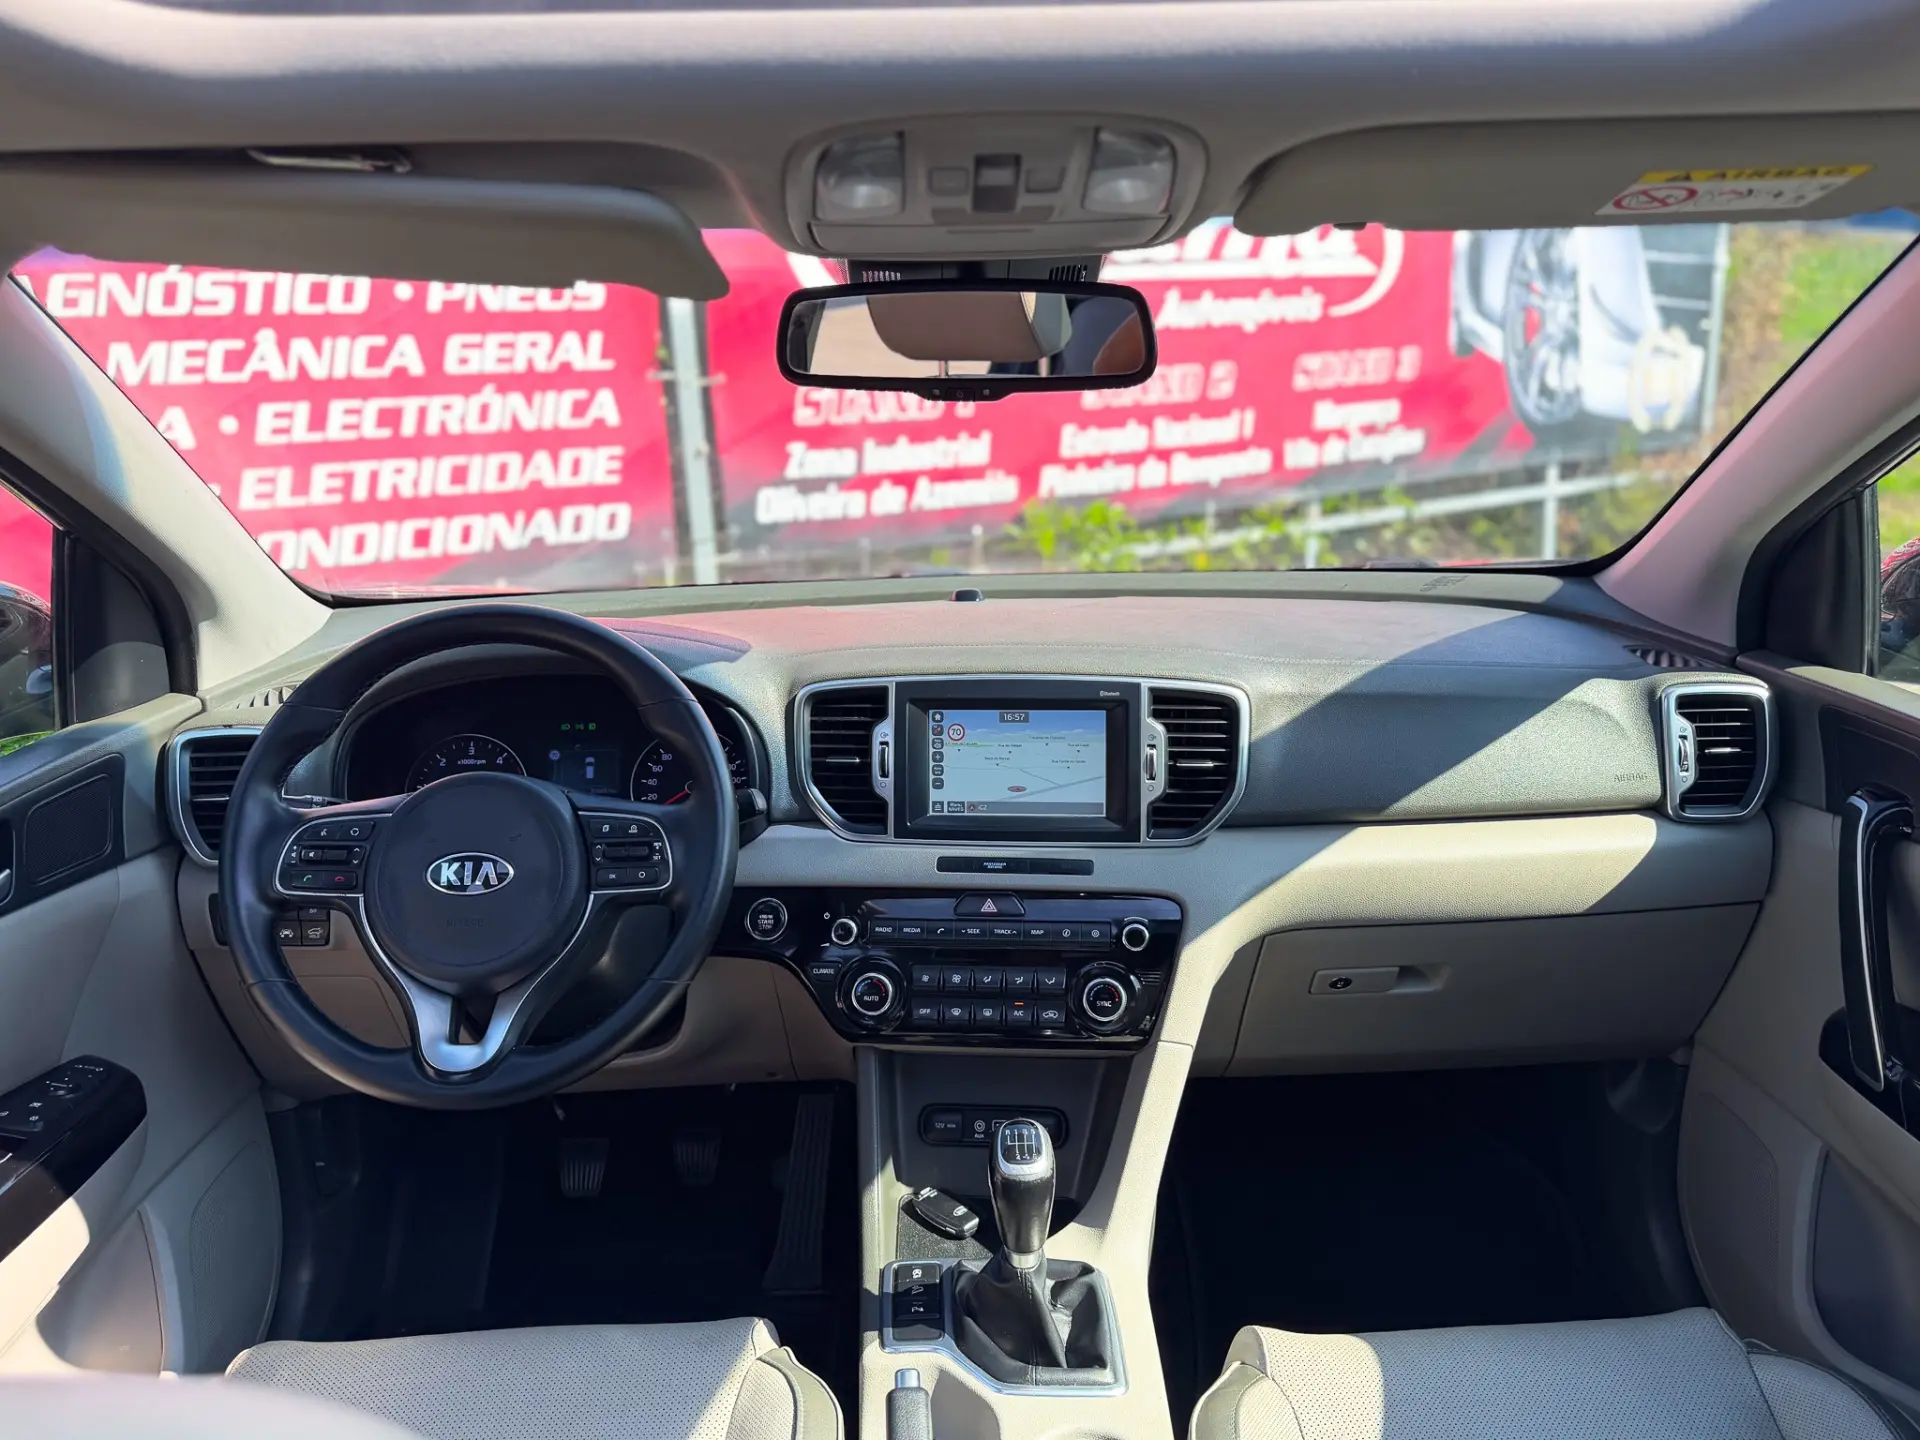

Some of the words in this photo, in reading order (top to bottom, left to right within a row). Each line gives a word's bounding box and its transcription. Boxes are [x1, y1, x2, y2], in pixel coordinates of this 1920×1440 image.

[1699, 167, 1851, 180] AIRBAG
[14, 264, 372, 318] GNÓSTICO
[106, 327, 426, 387] MECÂNICA
[443, 330, 617, 376] GERAL
[254, 383, 622, 446] ELECTRÓNICA
[237, 445, 625, 511] ELETRICIDADE
[1003, 713, 1025, 721] 16:57
[951, 728, 962, 736] 70
[468, 746, 475, 756] 3
[439, 757, 447, 767] 2
[496, 756, 504, 765] 4
[661, 753, 673, 761] 80
[652, 764, 663, 773] 60
[647, 778, 658, 787] 40
[647, 793, 658, 801] 20
[440, 861, 499, 886] KIA
[1096, 1000, 1112, 1008] SYNC
